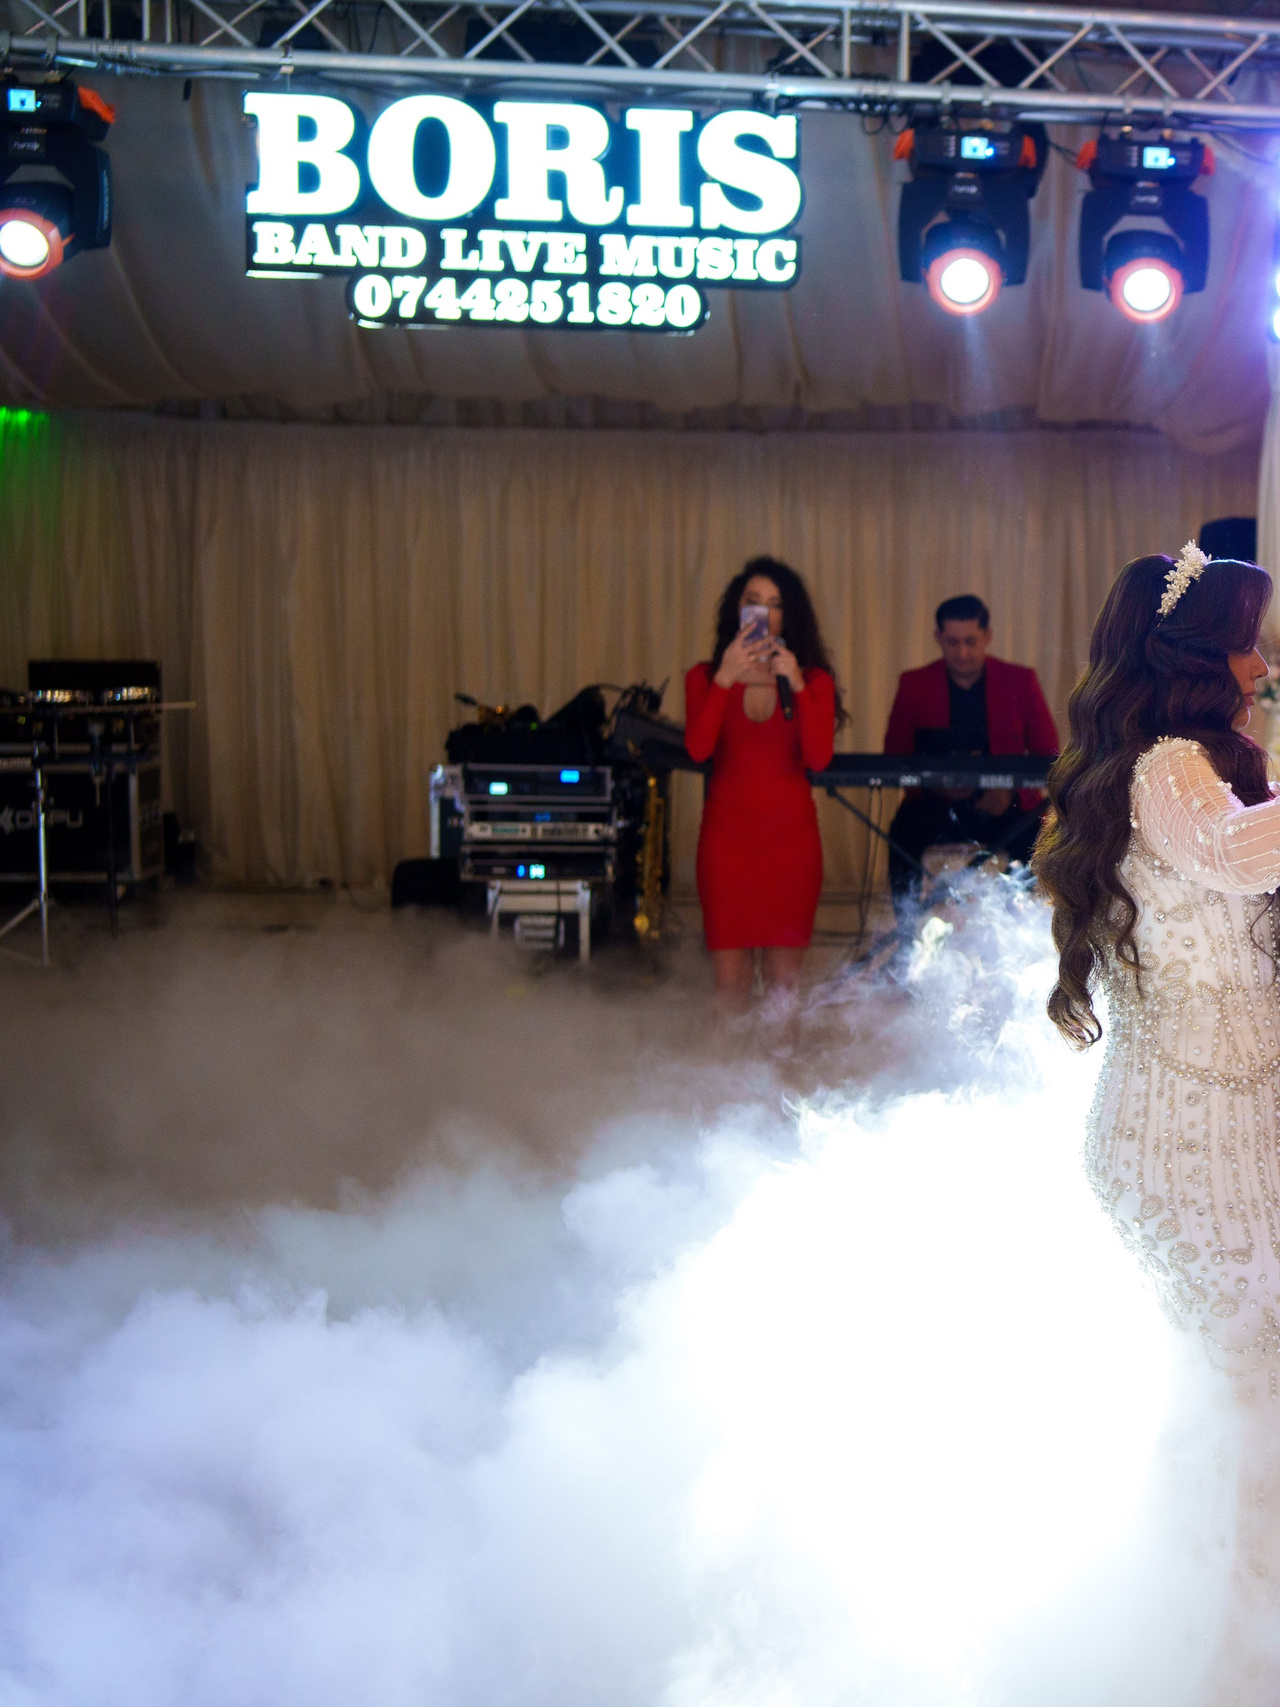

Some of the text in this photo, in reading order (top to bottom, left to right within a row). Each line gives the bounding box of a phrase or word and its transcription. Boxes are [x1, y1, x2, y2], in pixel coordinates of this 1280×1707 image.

[244, 93, 801, 233] BORIS
[253, 222, 797, 282] BAND LIVE MUSIC
[354, 274, 702, 327] 0744251820
